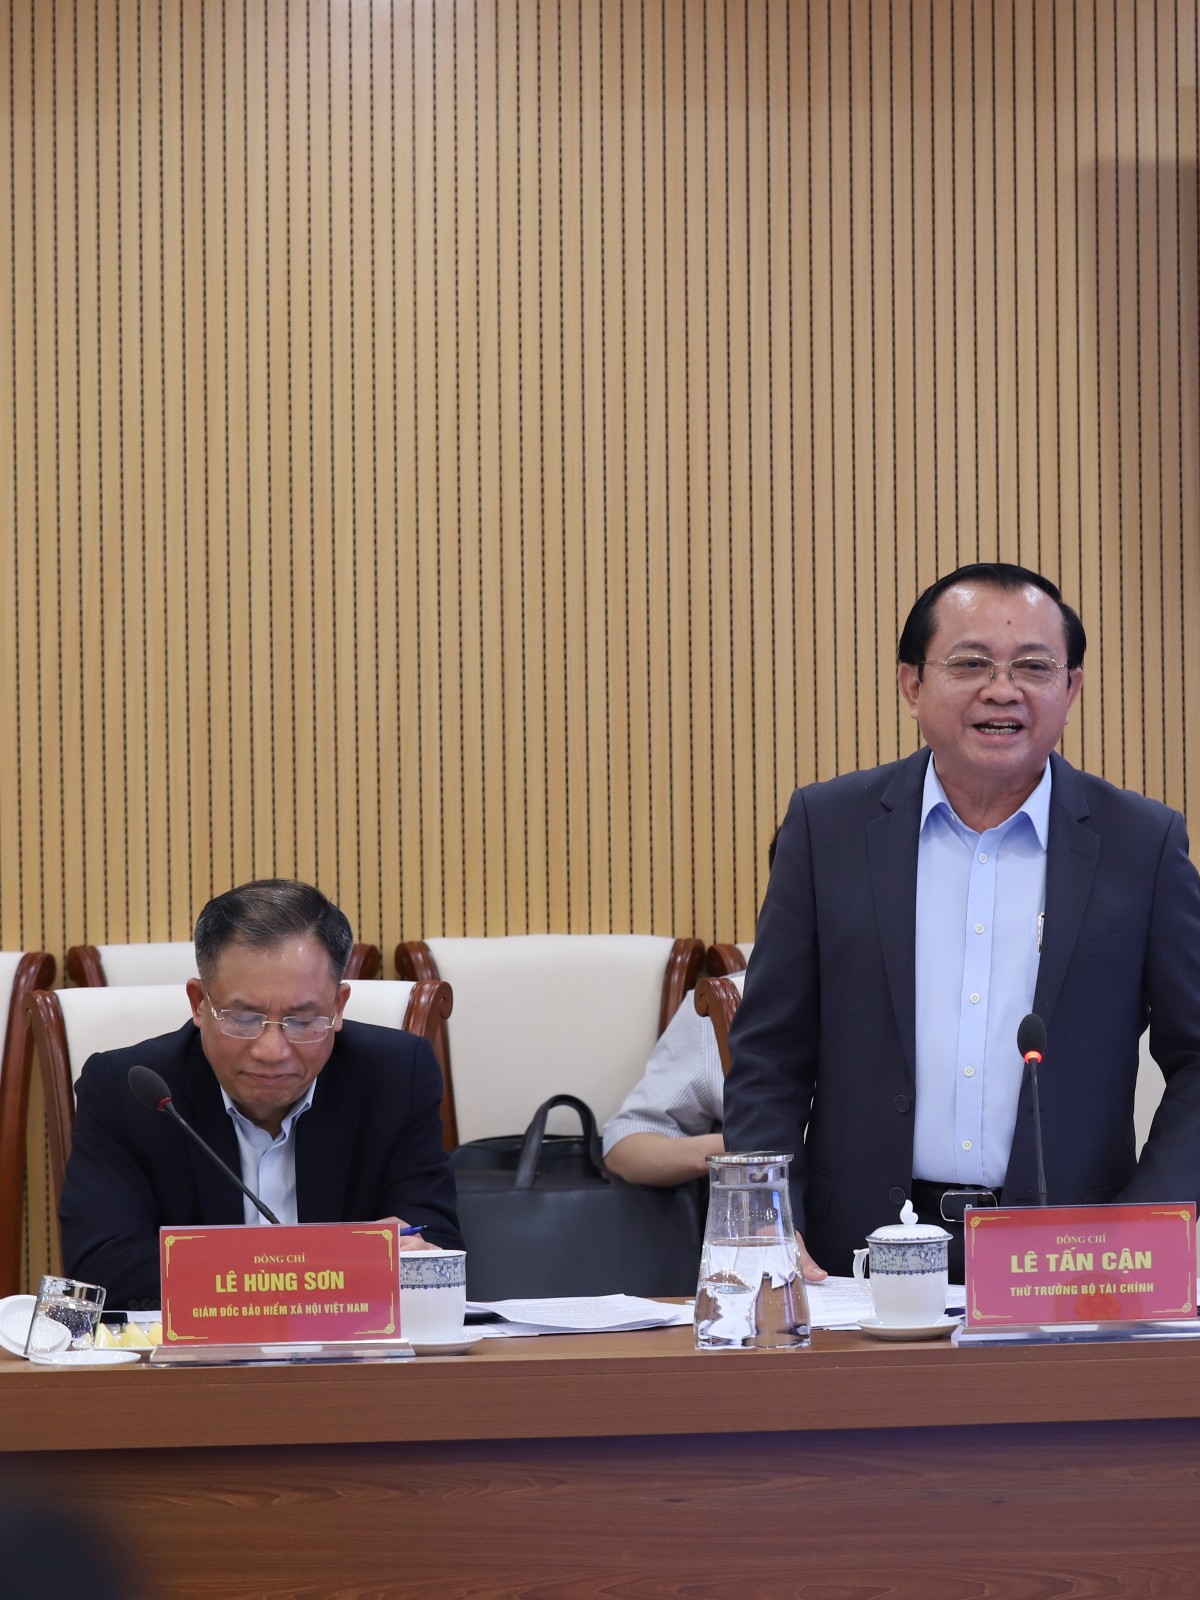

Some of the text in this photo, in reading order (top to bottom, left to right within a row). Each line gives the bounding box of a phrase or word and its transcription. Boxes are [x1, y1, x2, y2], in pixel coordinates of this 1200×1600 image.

[1088, 1233, 1106, 1244] CHÍ
[286, 1252, 305, 1263] CHÍ
[1010, 1247, 1152, 1274] LÊ TẤN CẬN
[215, 1269, 345, 1293] LÊ HÙNG SƠN
[1081, 1283, 1096, 1297] BỘ
[1100, 1281, 1117, 1295] TÀI
[1120, 1281, 1154, 1294] CHÍNH
[192, 1304, 218, 1318] GIÁM
[220, 1302, 239, 1317] ĐỐC
[241, 1302, 261, 1316] BẢO
[263, 1301, 288, 1316] HIỂM
[305, 1302, 322, 1316] HỘI
[324, 1301, 345, 1316] VIỆT
[347, 1302, 369, 1314] NAM
